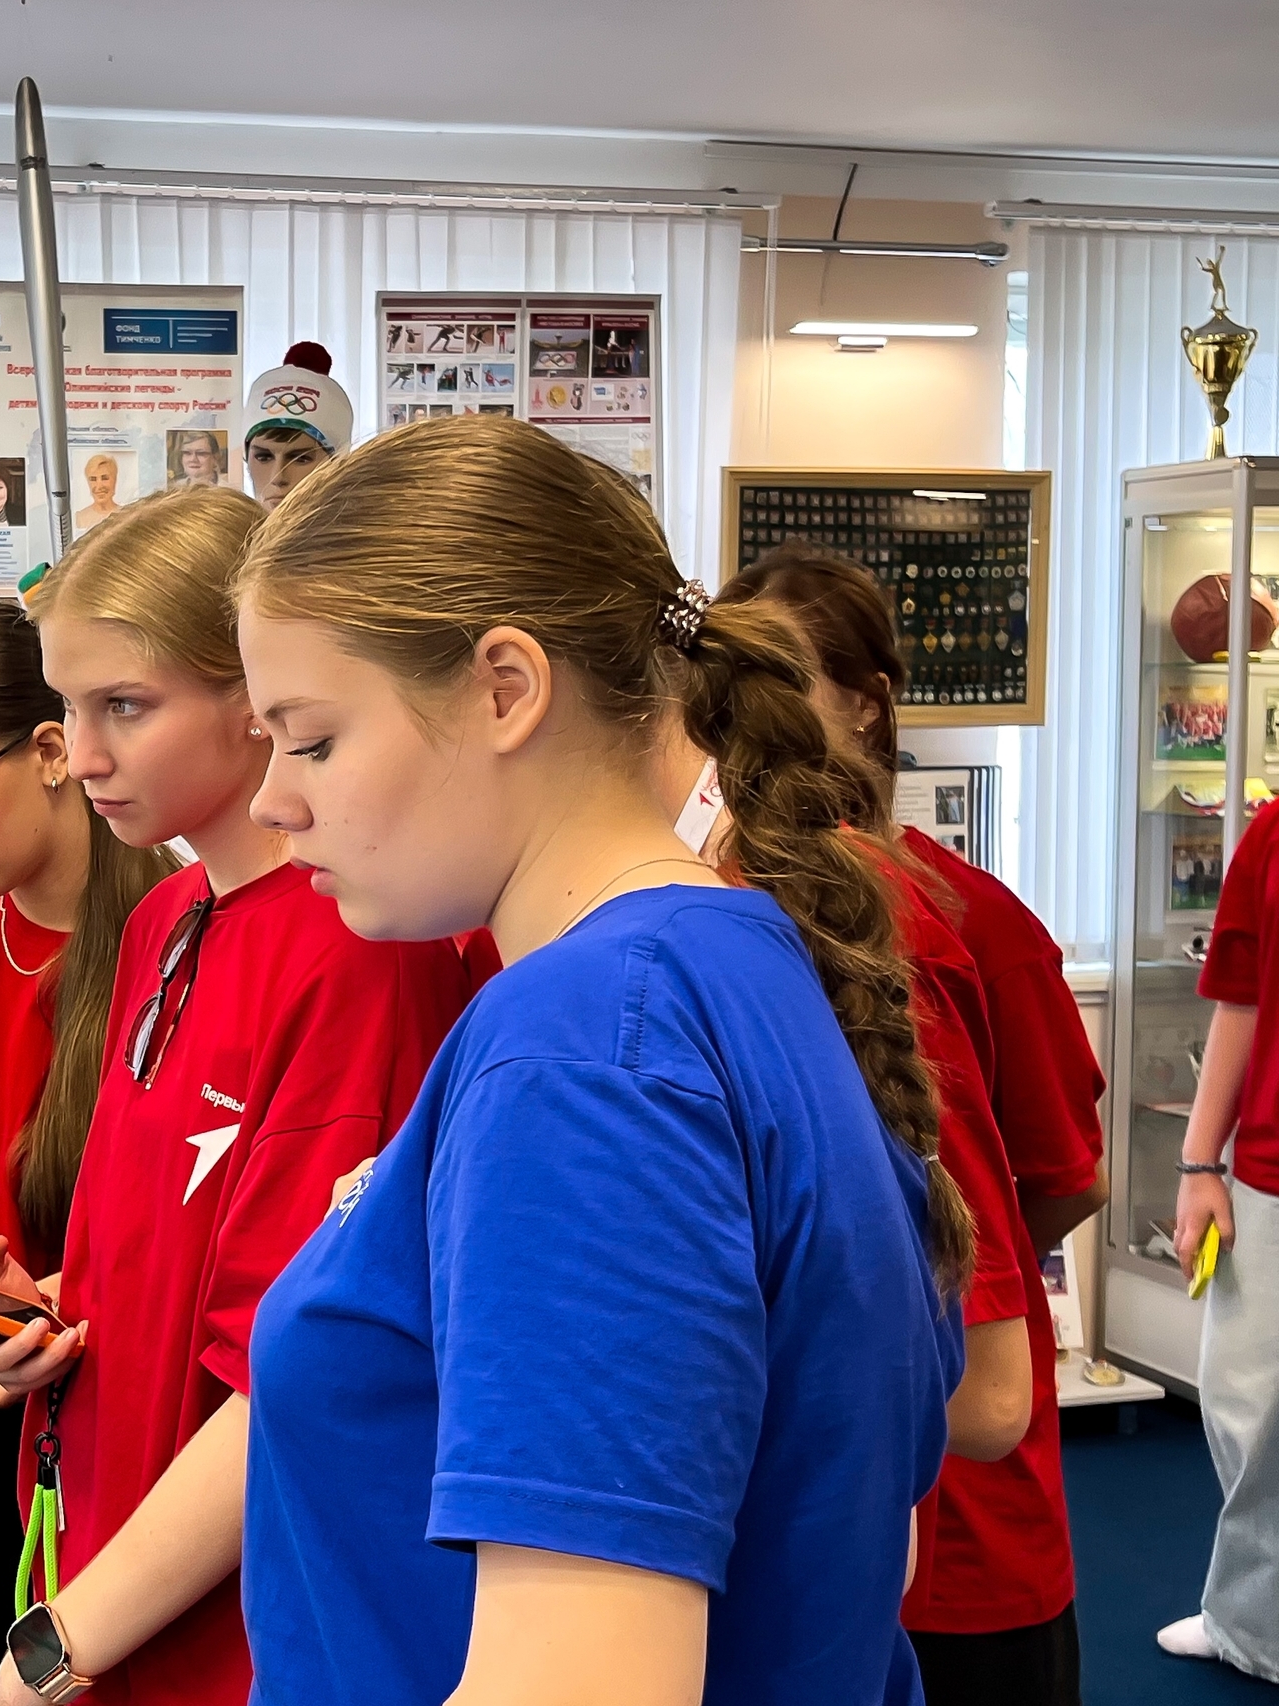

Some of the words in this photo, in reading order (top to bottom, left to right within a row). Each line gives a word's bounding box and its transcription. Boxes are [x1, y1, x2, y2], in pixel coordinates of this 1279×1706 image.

[115, 325, 140, 333] ФОНД
[115, 335, 161, 344] ТИМЧЕНКО
[158, 401, 189, 412] спорту
[201, 1083, 246, 1113] Первы
